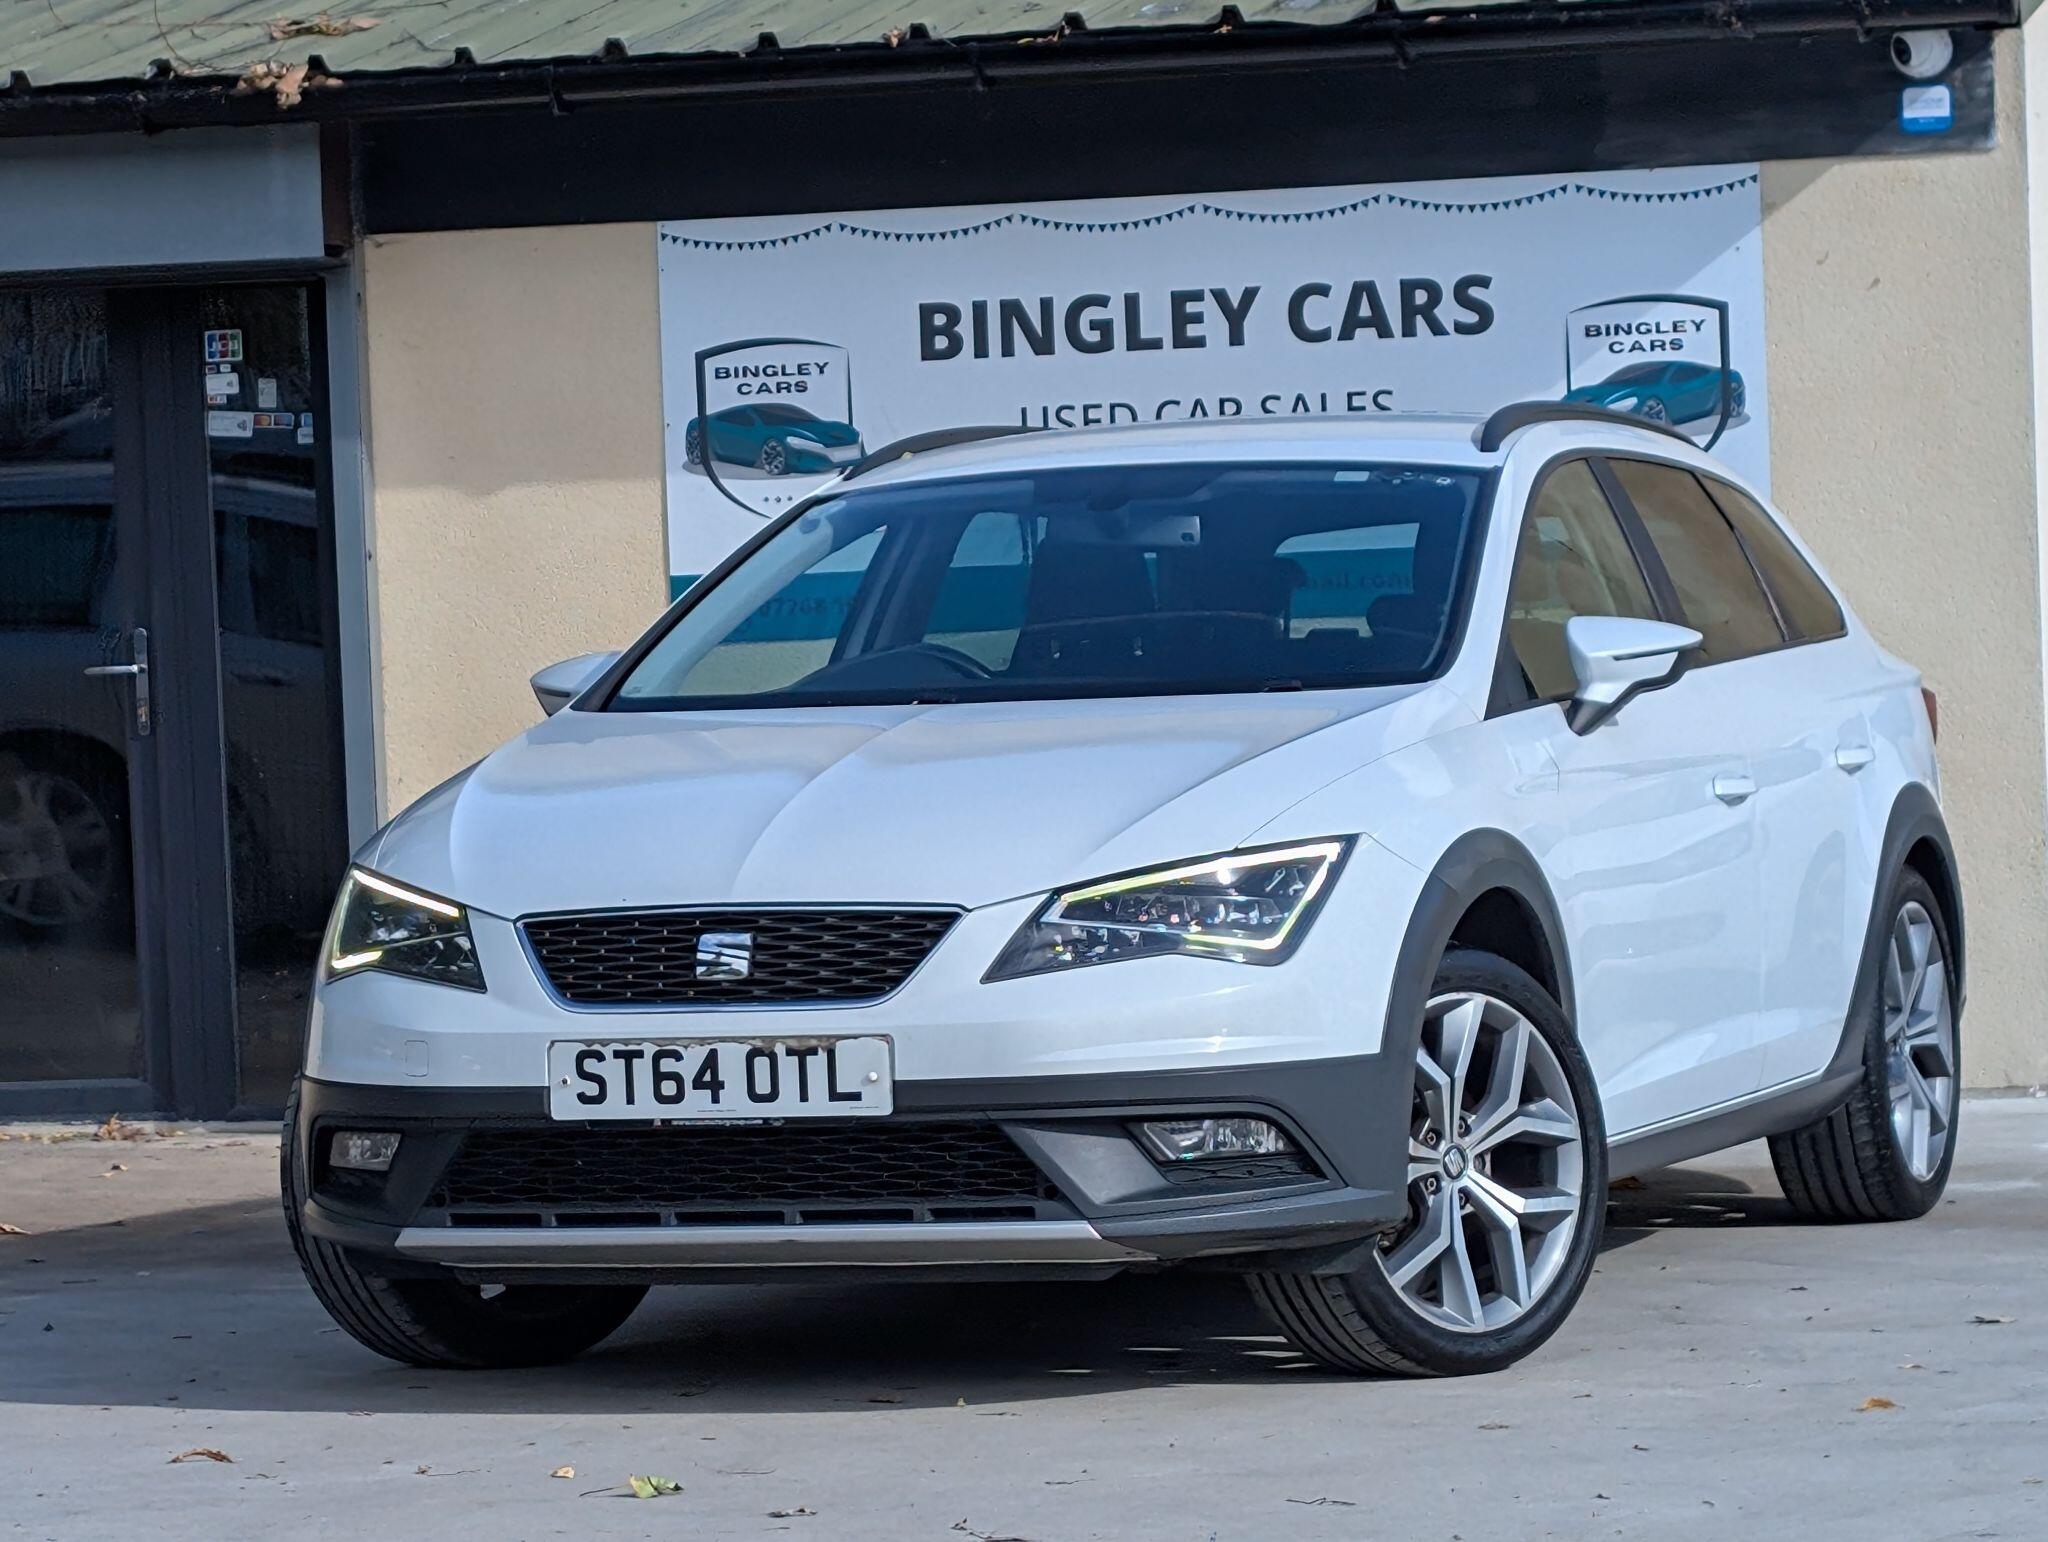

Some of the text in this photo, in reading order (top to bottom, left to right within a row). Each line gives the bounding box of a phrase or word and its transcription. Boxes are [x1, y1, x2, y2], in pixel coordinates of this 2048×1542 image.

[919, 274, 1495, 361] BINGLEY CARS
[1583, 319, 1705, 339] BINGLEY
[1607, 338, 1685, 354] CARS
[713, 361, 830, 380] BINGLEY
[736, 380, 809, 396] CARS
[575, 1046, 862, 1106] ST64 OTL
